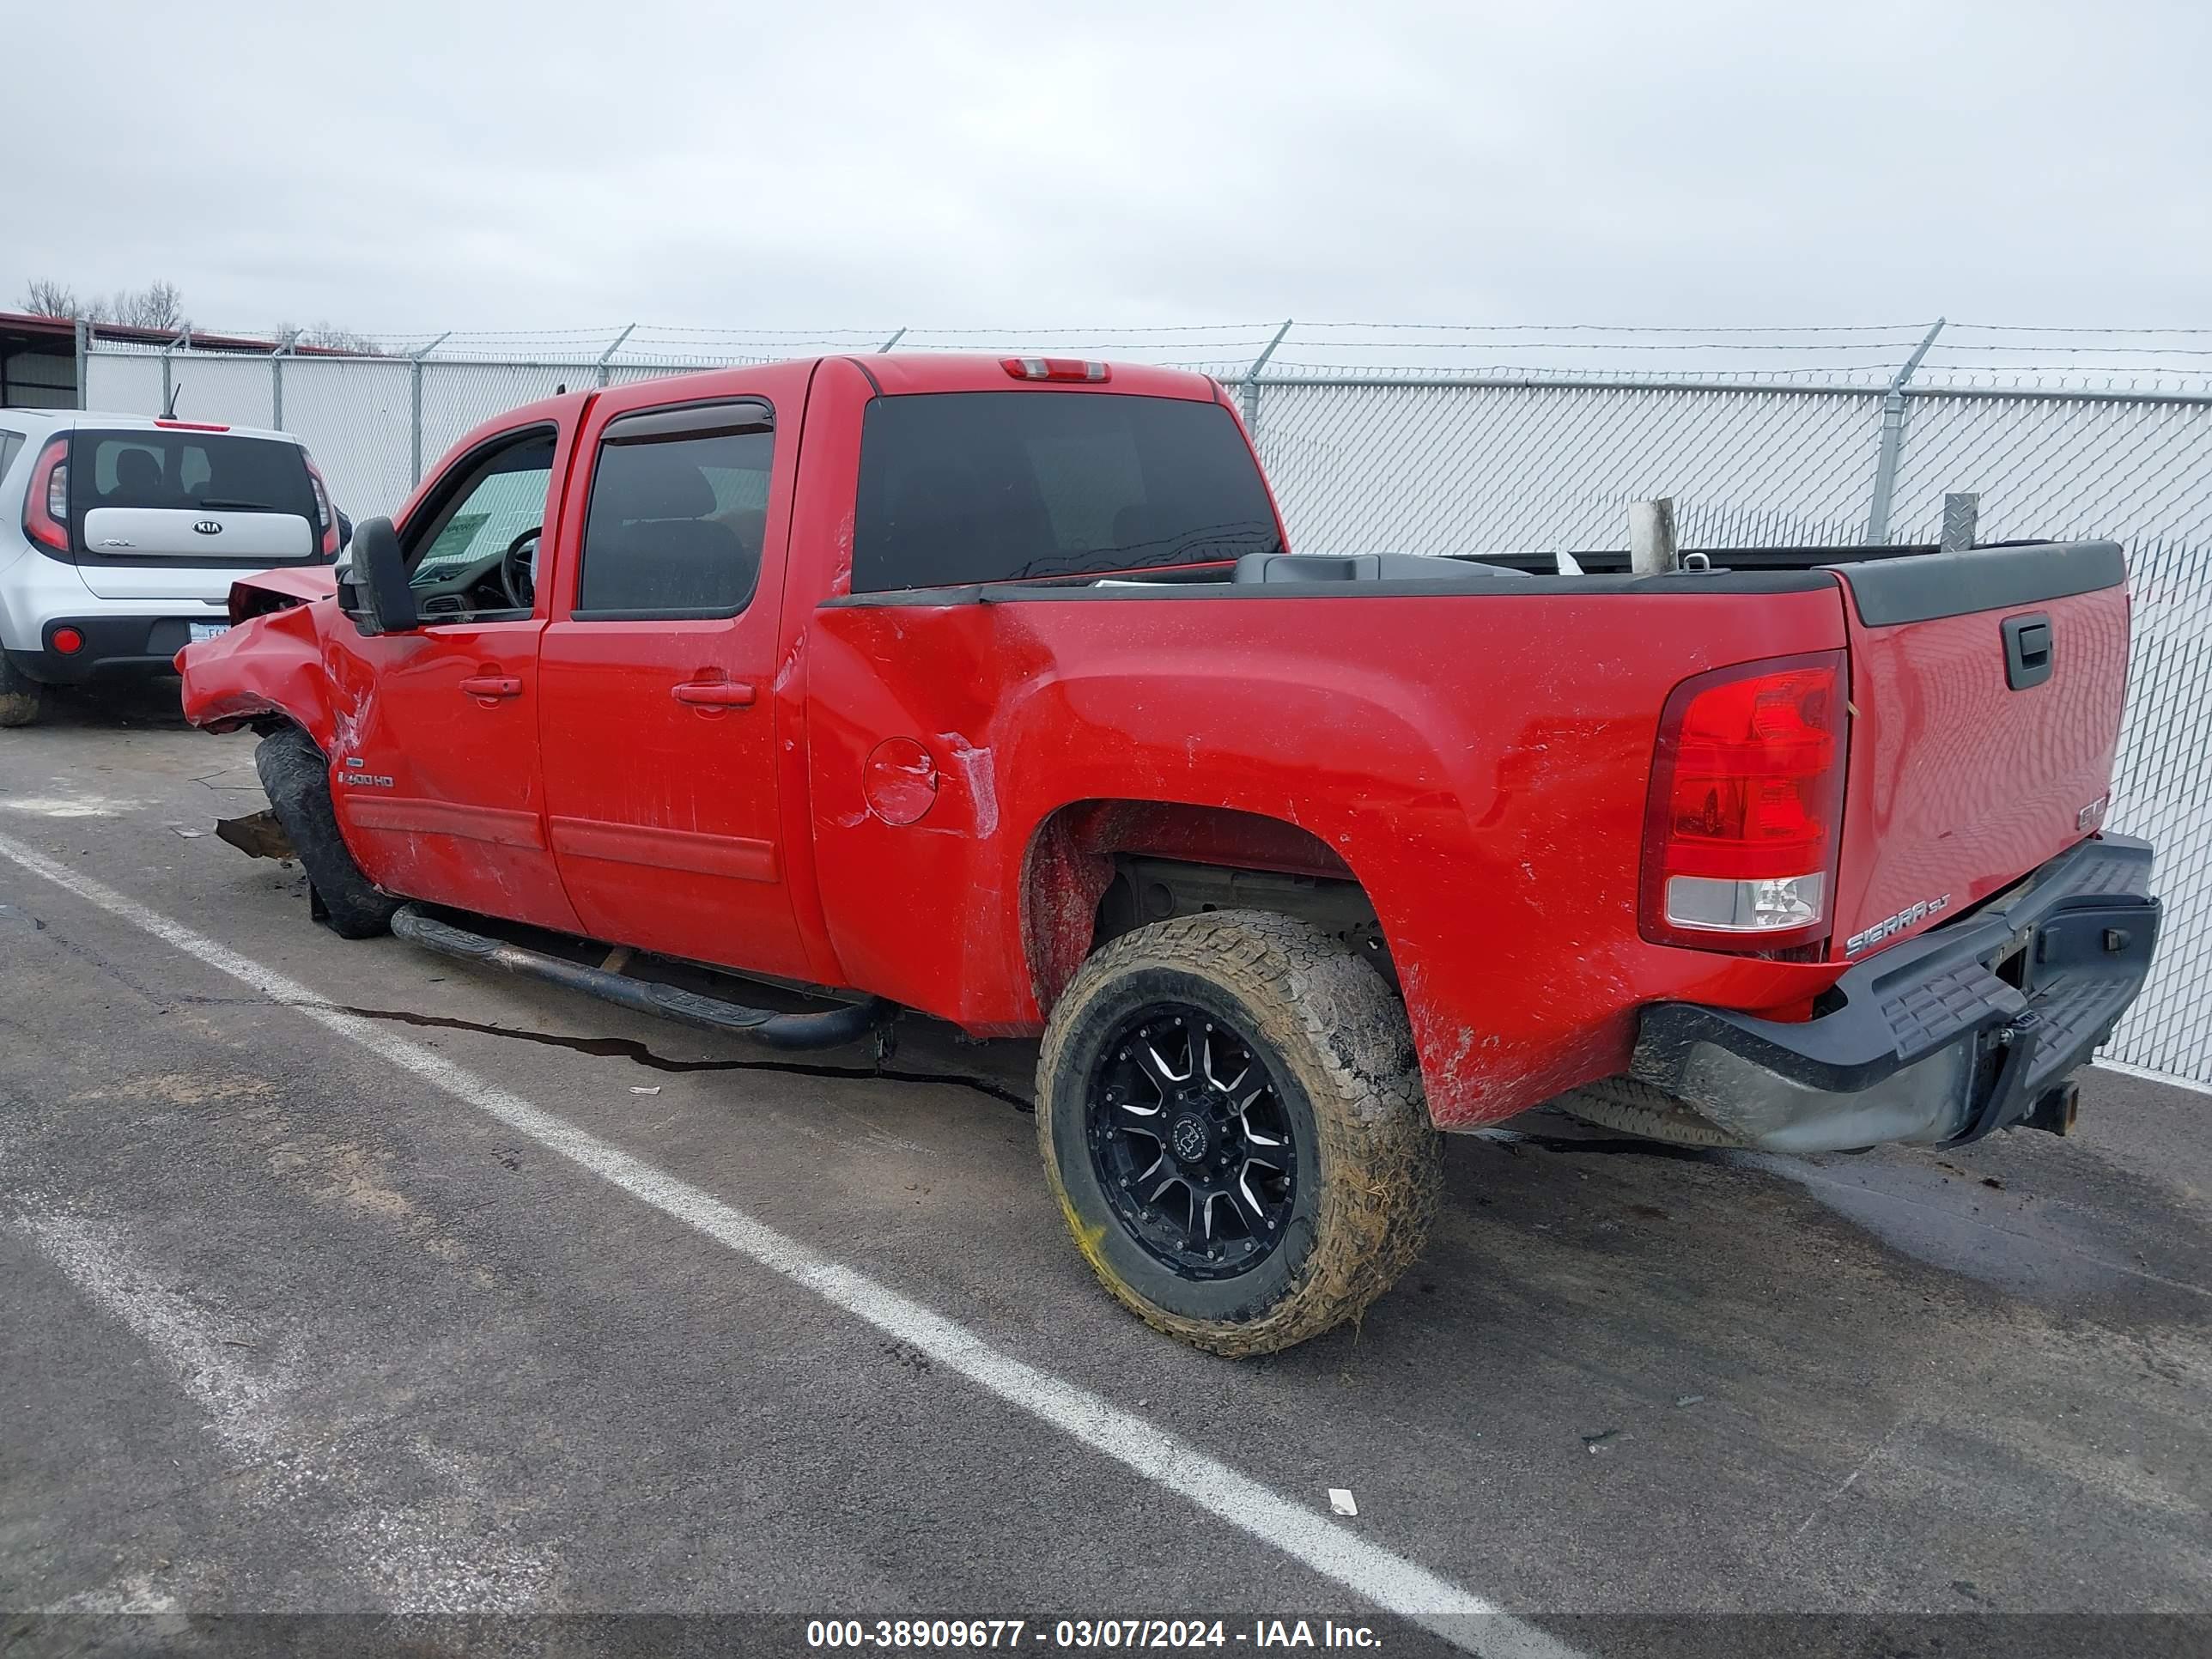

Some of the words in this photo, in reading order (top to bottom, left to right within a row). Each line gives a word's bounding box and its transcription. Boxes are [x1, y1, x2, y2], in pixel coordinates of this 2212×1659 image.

[198, 522, 220, 532] KIA
[1845, 900, 1927, 958] SIERRA
[1929, 894, 1950, 915] SLT
